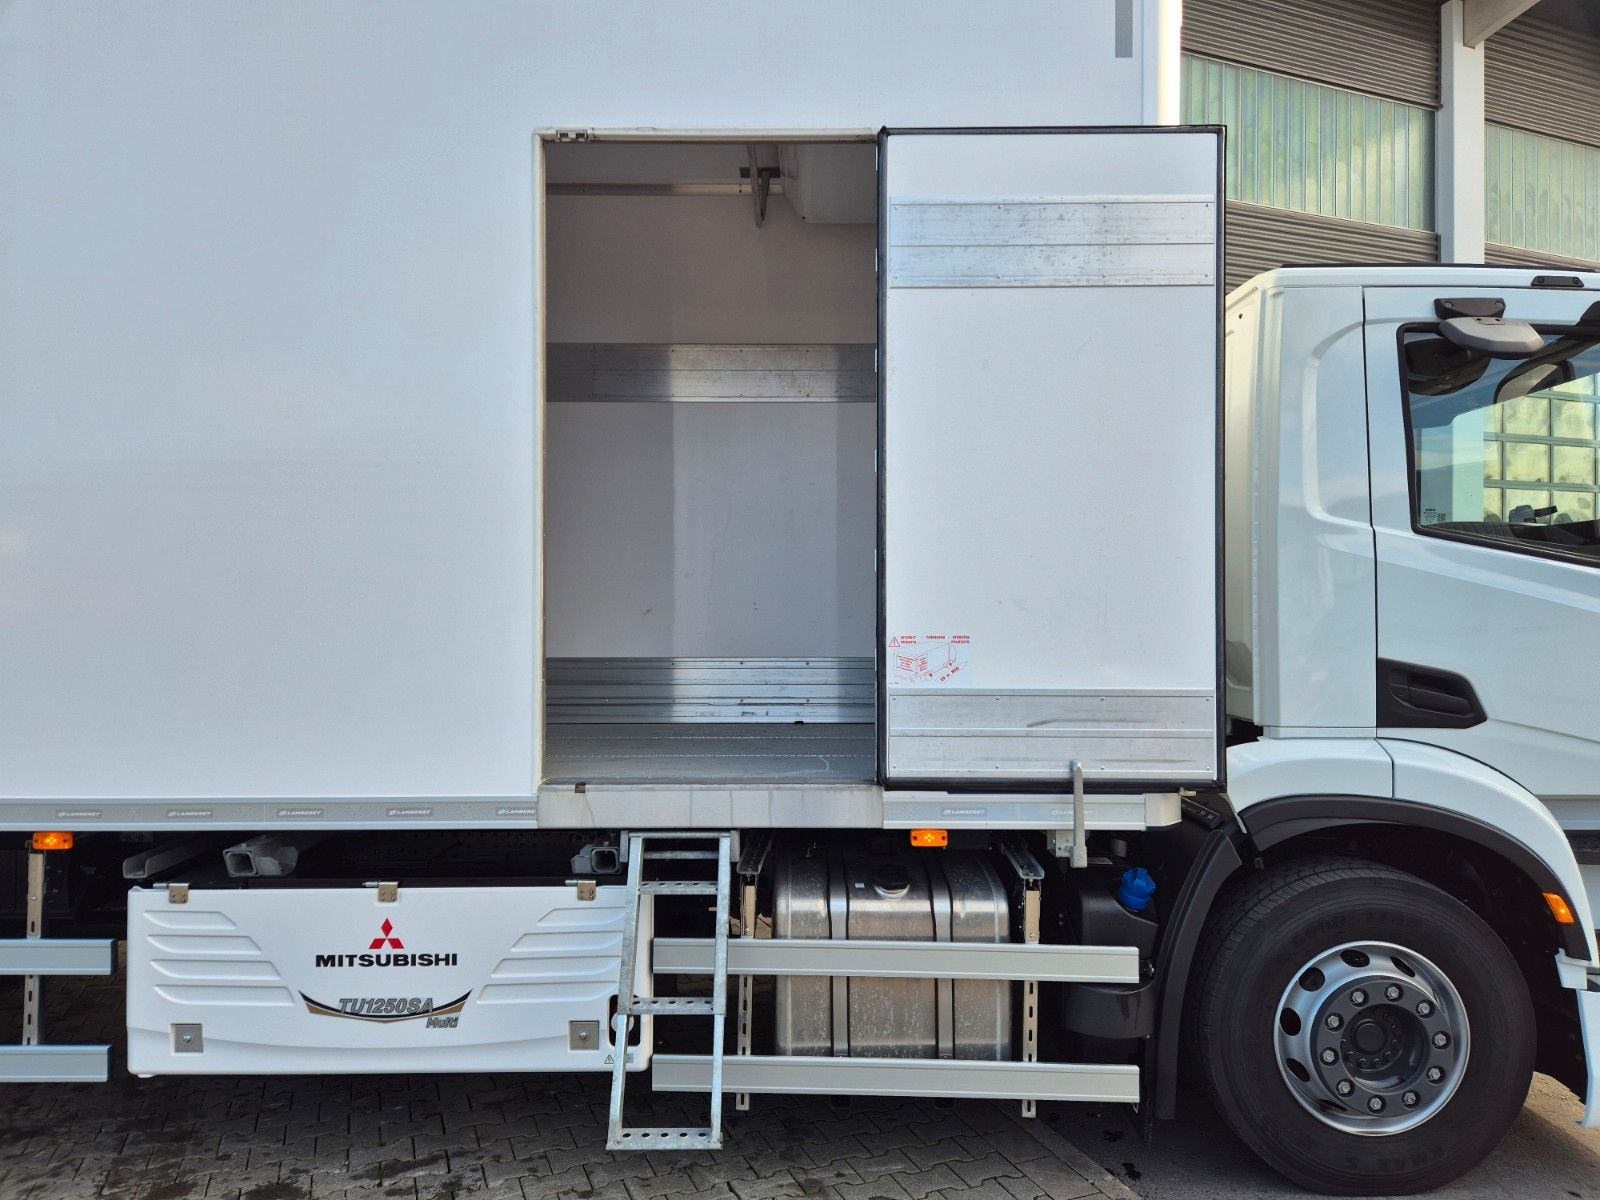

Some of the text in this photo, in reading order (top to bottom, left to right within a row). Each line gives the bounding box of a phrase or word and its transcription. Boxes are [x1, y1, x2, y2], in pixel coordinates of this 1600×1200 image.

[315, 953, 457, 967] MITSUBISHI
[338, 997, 433, 1014] TU1250SA
[426, 1016, 459, 1029] Multi
